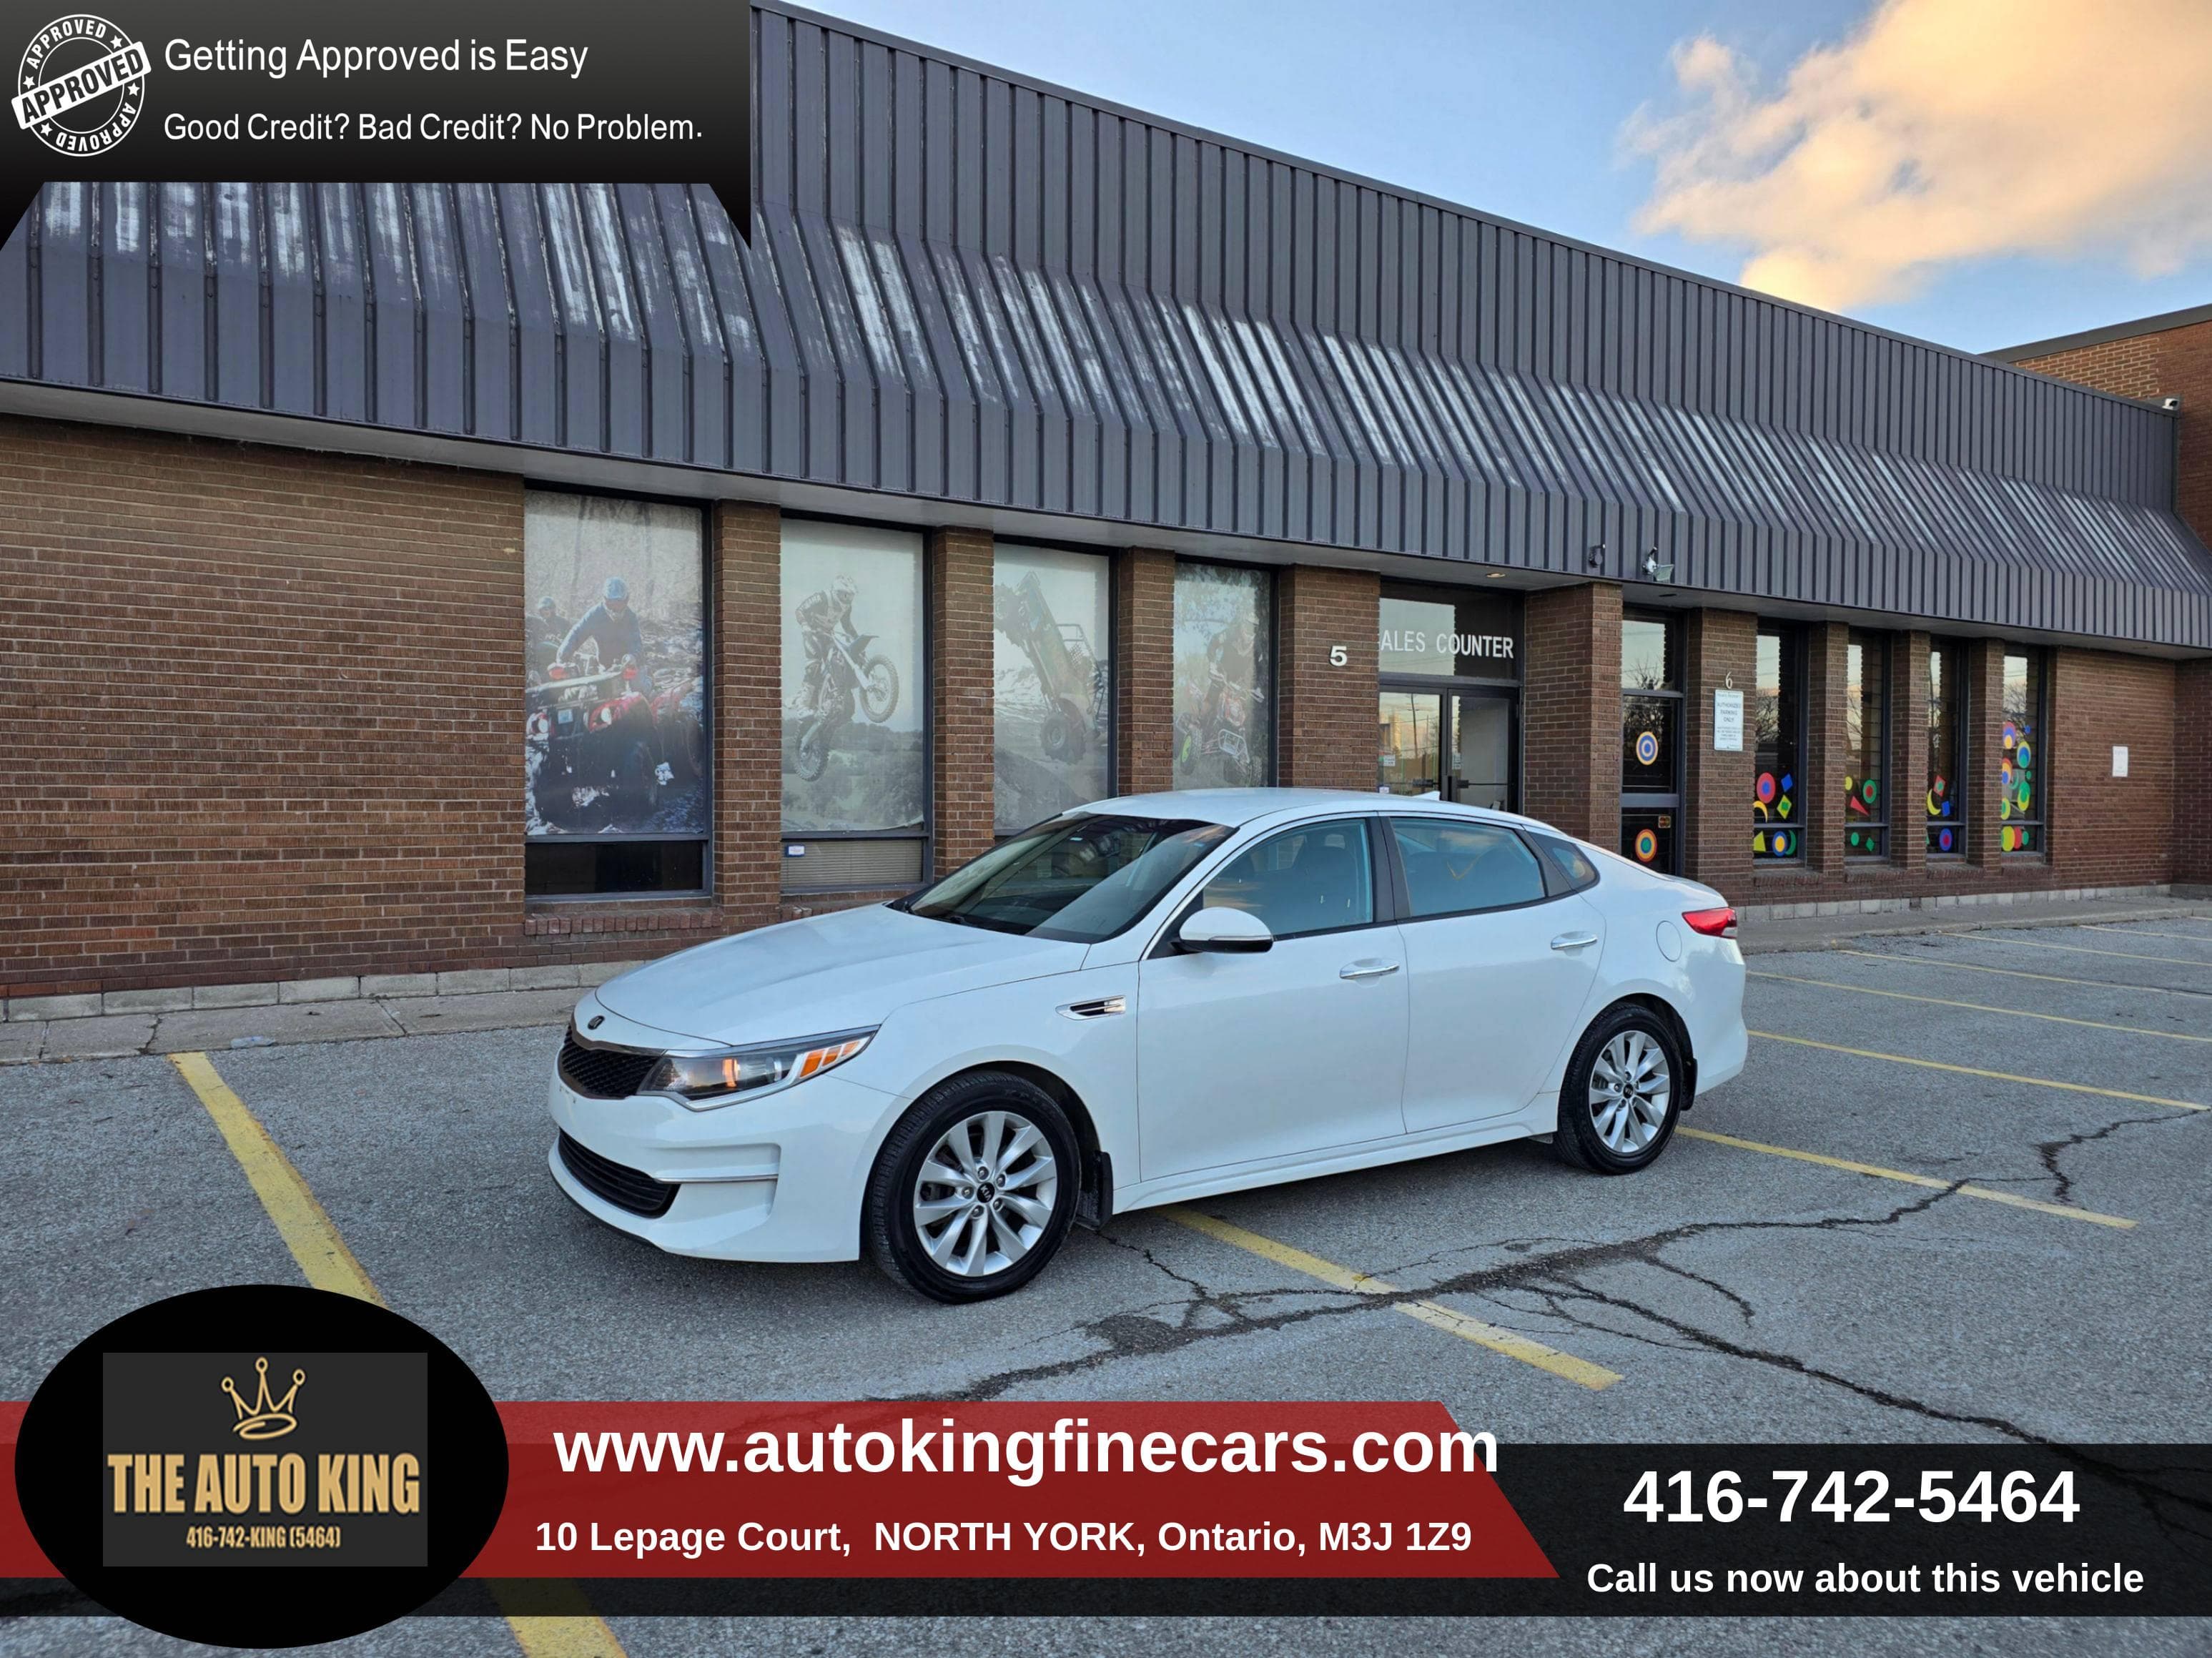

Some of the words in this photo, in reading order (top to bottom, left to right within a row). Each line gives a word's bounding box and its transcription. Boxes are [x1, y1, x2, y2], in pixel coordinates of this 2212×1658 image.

[1379, 629, 1426, 653] ALES
[1436, 633, 1514, 658] COUNTER
[1329, 645, 1348, 666] 5
[1725, 671, 1733, 689] 6
